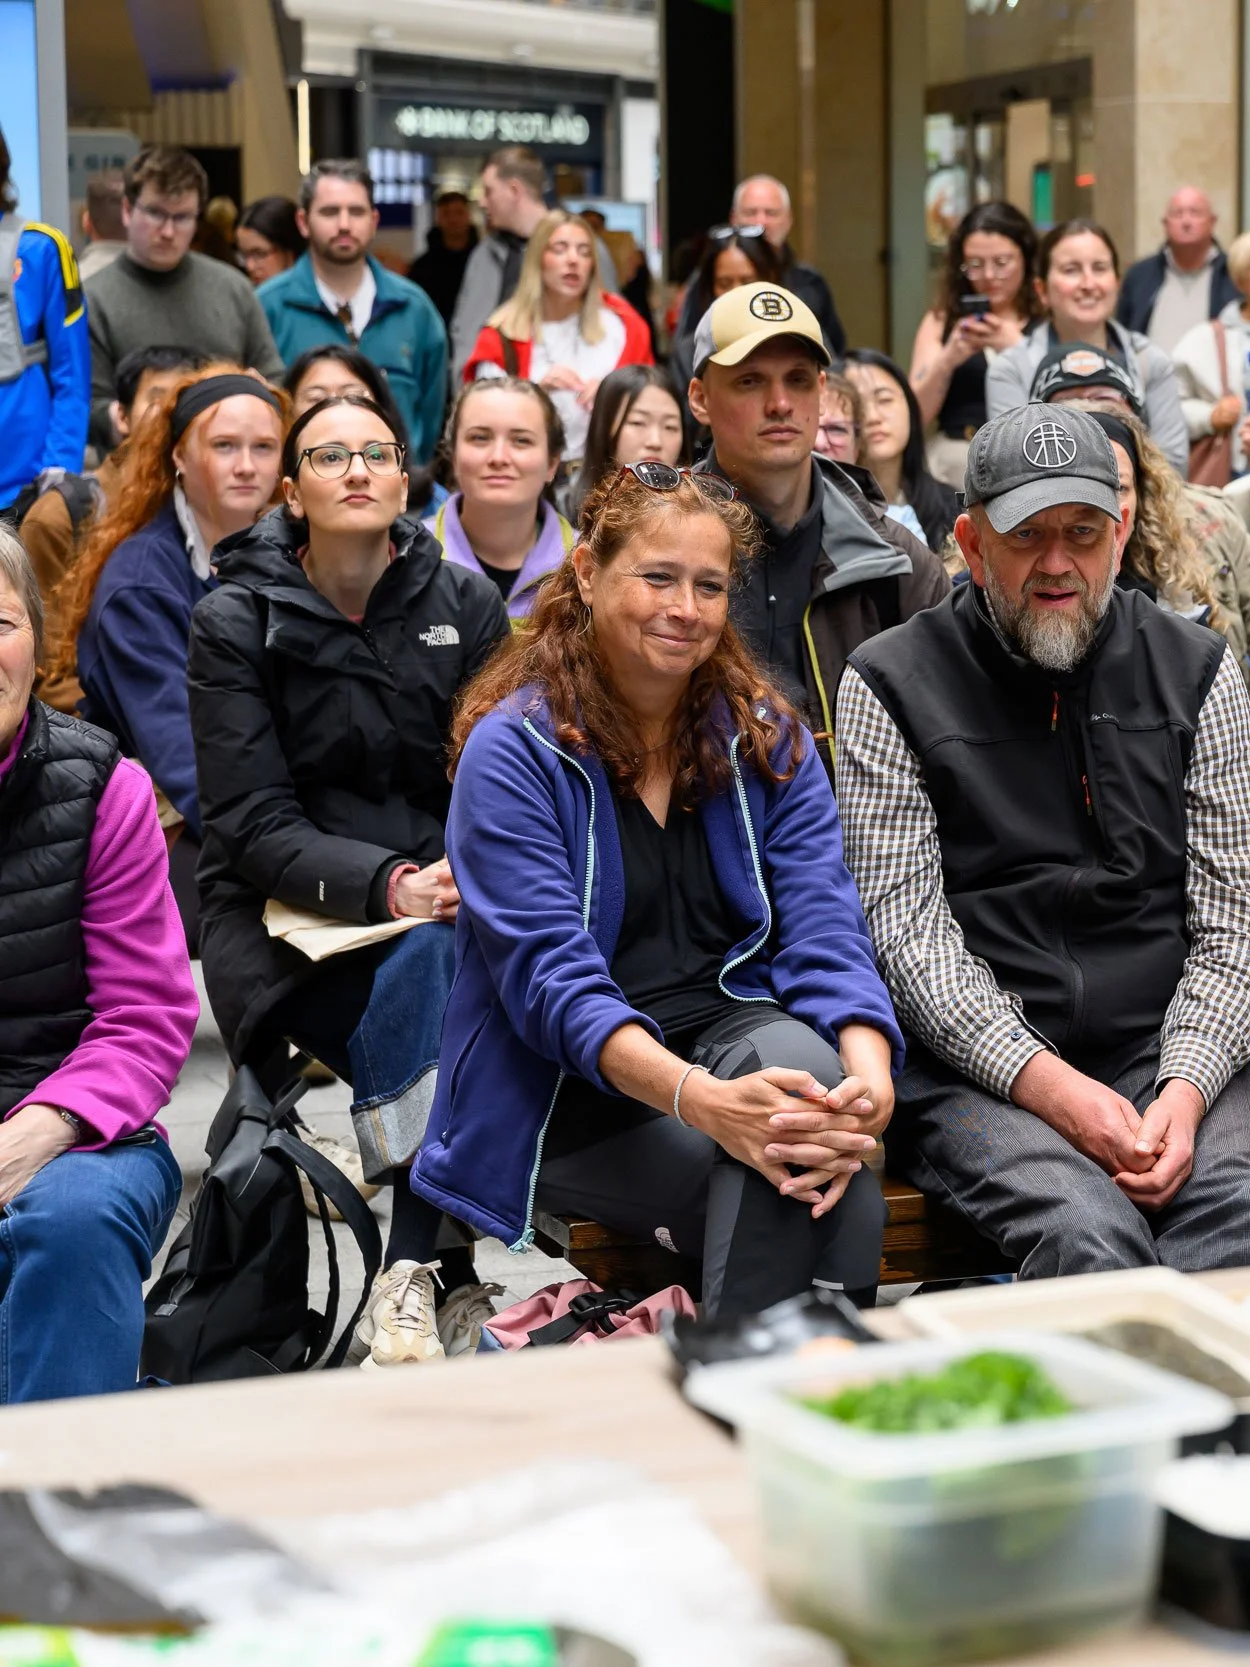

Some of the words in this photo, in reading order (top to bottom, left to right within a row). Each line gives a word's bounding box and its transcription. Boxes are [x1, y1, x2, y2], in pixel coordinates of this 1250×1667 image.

[418, 106, 470, 139] BANK
[469, 109, 496, 141] OF
[497, 110, 590, 146] SCOTLAND
[419, 633, 446, 641] NORTH
[427, 639, 446, 647] FACE
